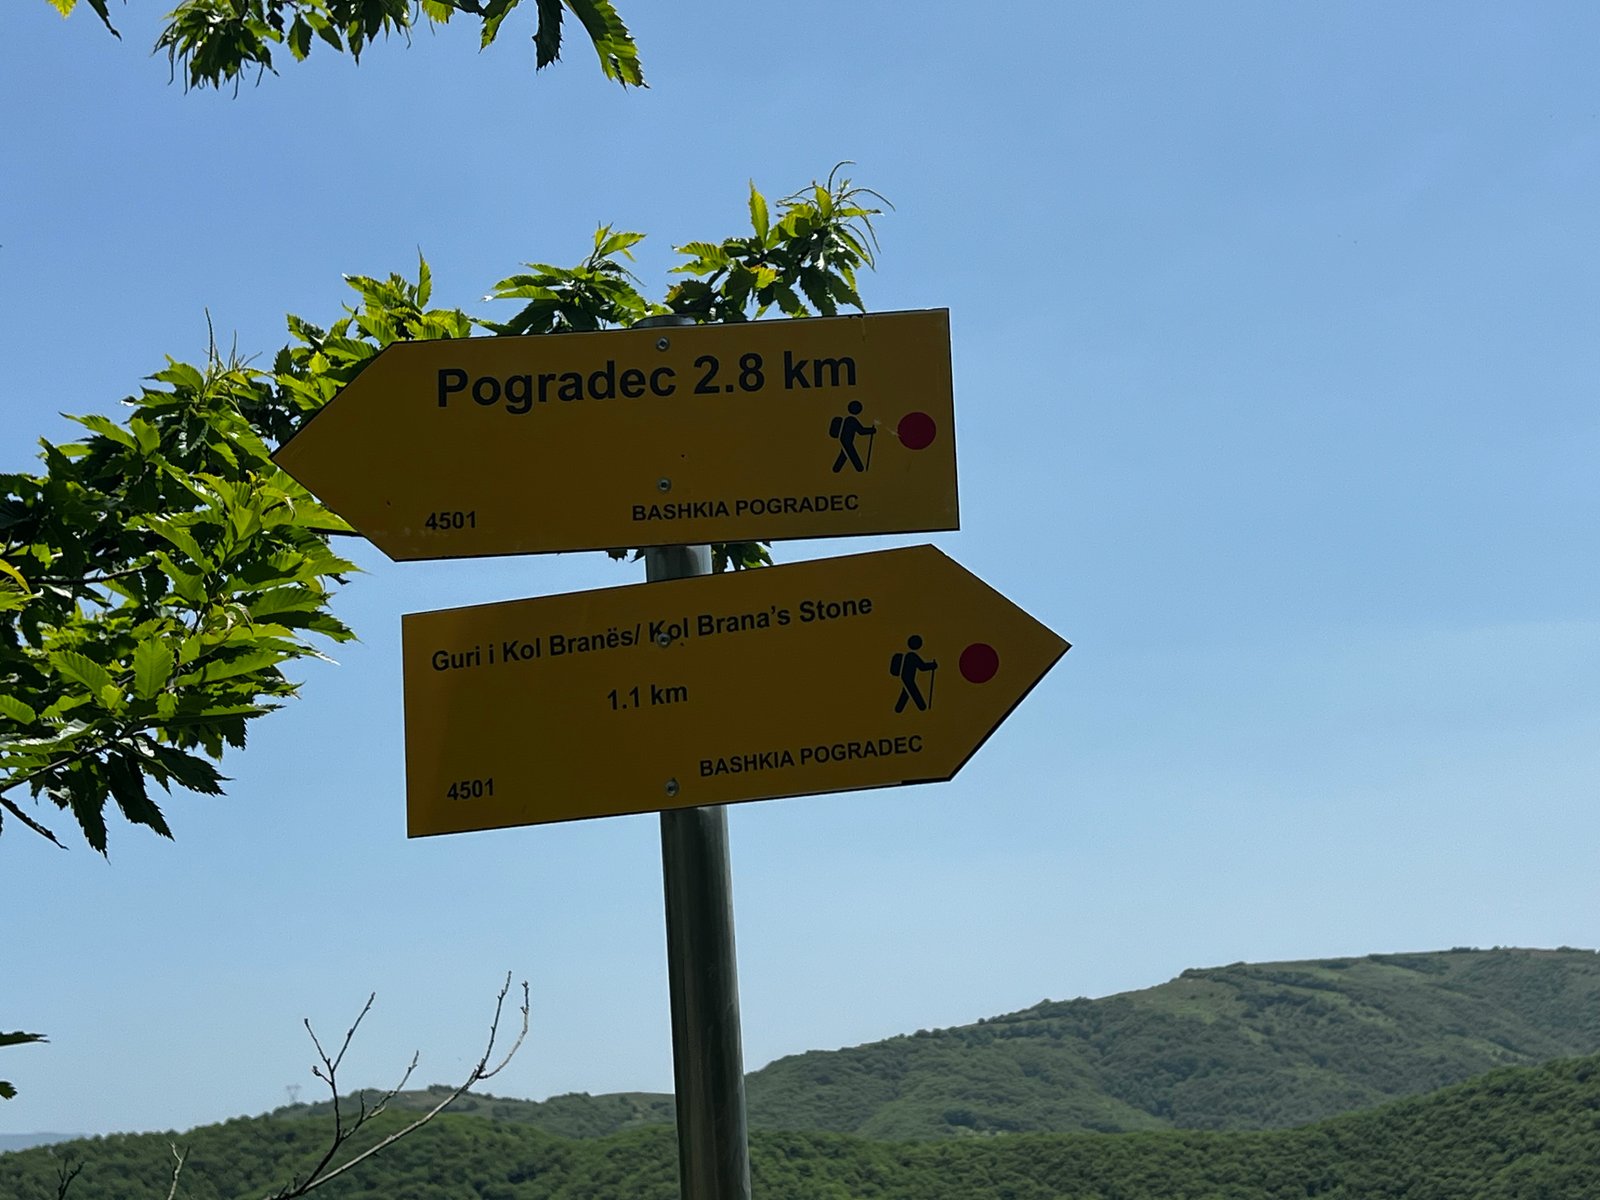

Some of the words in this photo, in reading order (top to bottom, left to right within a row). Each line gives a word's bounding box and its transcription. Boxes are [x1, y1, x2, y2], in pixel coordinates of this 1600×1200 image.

[437, 359, 676, 415] Pogradec
[693, 352, 765, 395] 2.8
[783, 350, 856, 390] km
[424, 510, 477, 531] 4501
[632, 500, 730, 521] BASHKIA
[735, 494, 859, 517] POGRADEC
[431, 645, 481, 672] Guri
[489, 643, 495, 665] i
[502, 637, 541, 663] Kol
[549, 623, 641, 657] Branës/
[649, 617, 689, 644] Kol
[799, 598, 872, 623] Stone
[607, 686, 640, 711] 1.1
[650, 684, 688, 706] km
[699, 750, 795, 777] BASHKIA
[800, 734, 923, 765] POGRADEC
[446, 778, 494, 801] 4501
